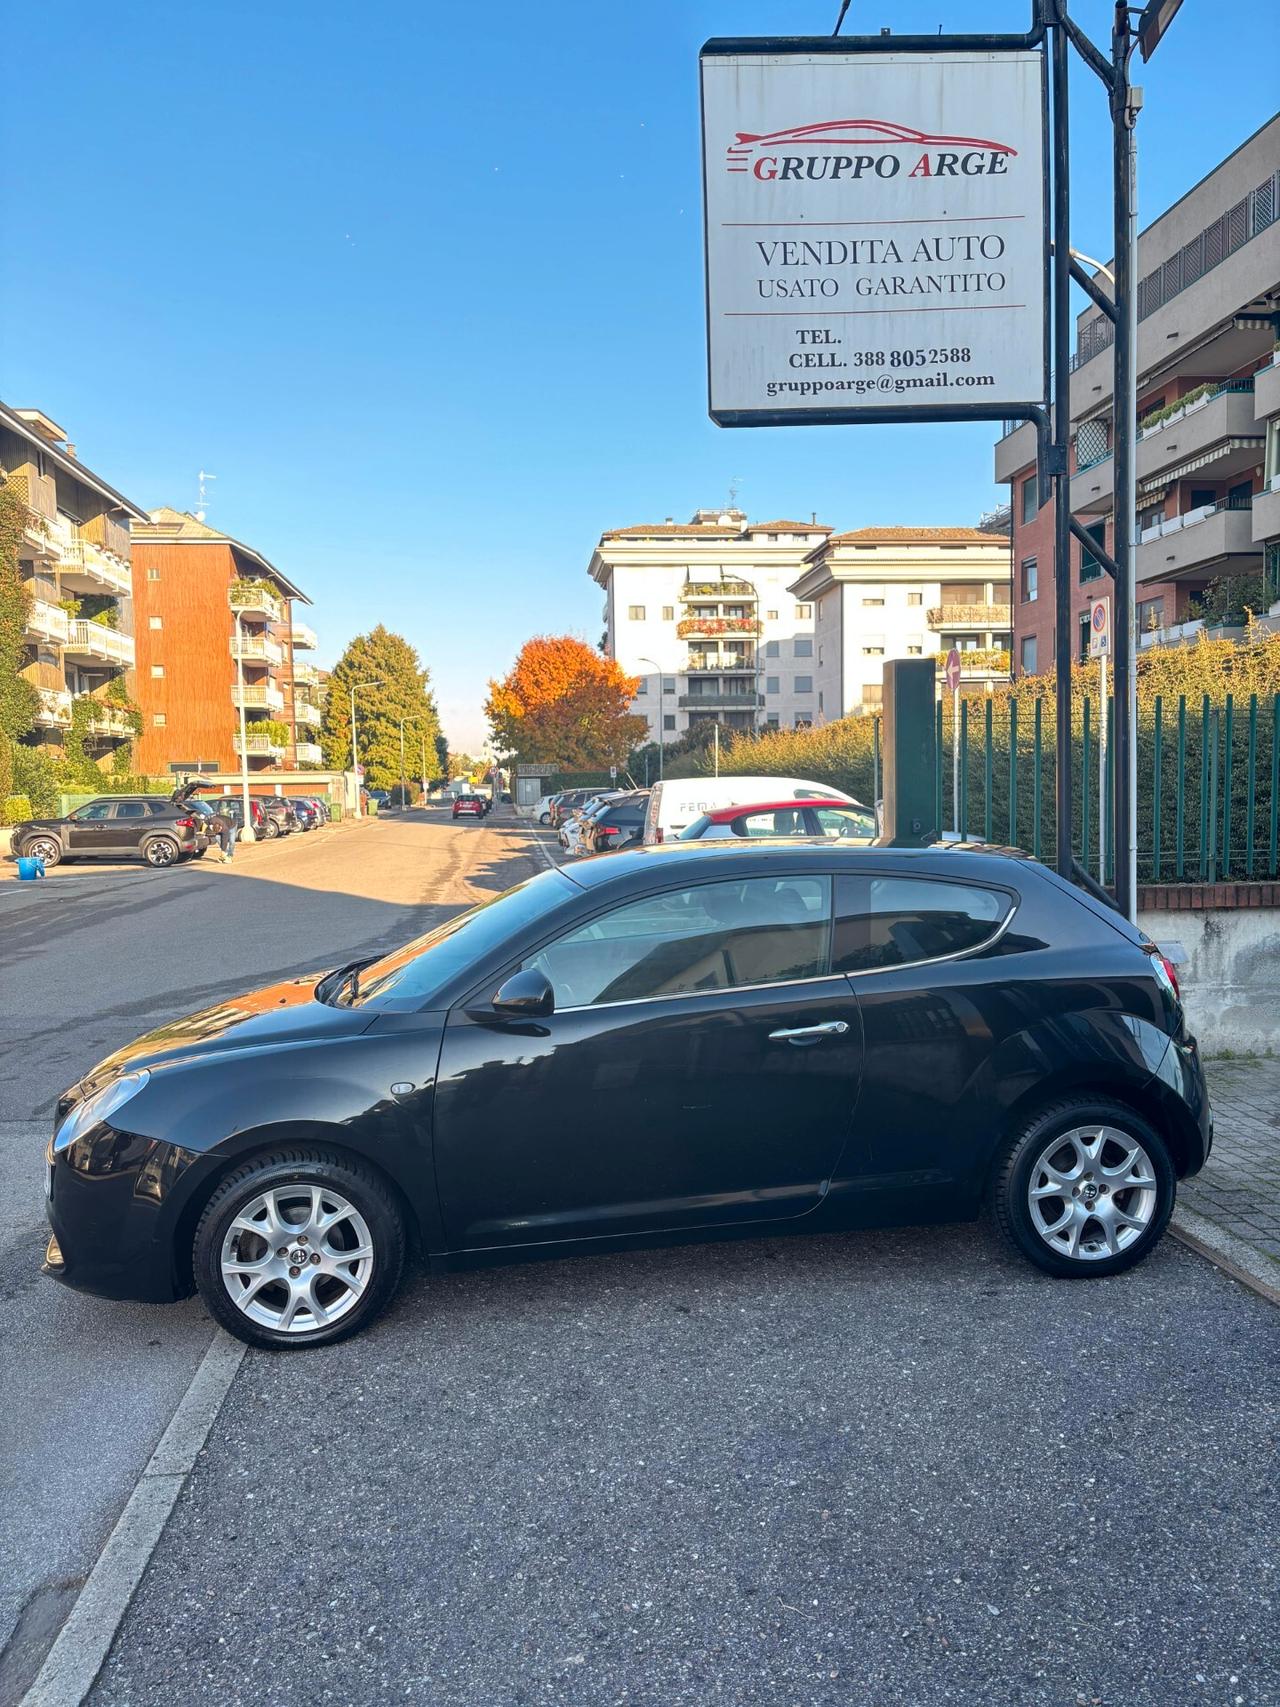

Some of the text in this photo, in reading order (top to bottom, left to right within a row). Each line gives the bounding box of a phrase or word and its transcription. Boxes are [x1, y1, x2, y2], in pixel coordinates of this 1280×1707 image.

[754, 151, 1009, 180] GRUPPO ARGE
[755, 235, 1004, 266] VENDITA AUTO
[757, 273, 1005, 298] USATO GARANTITO
[796, 330, 841, 344] TEL.
[789, 353, 847, 368] CELL.
[854, 351, 885, 366] 388
[767, 372, 995, 396] gruppoarge@gmail.com
